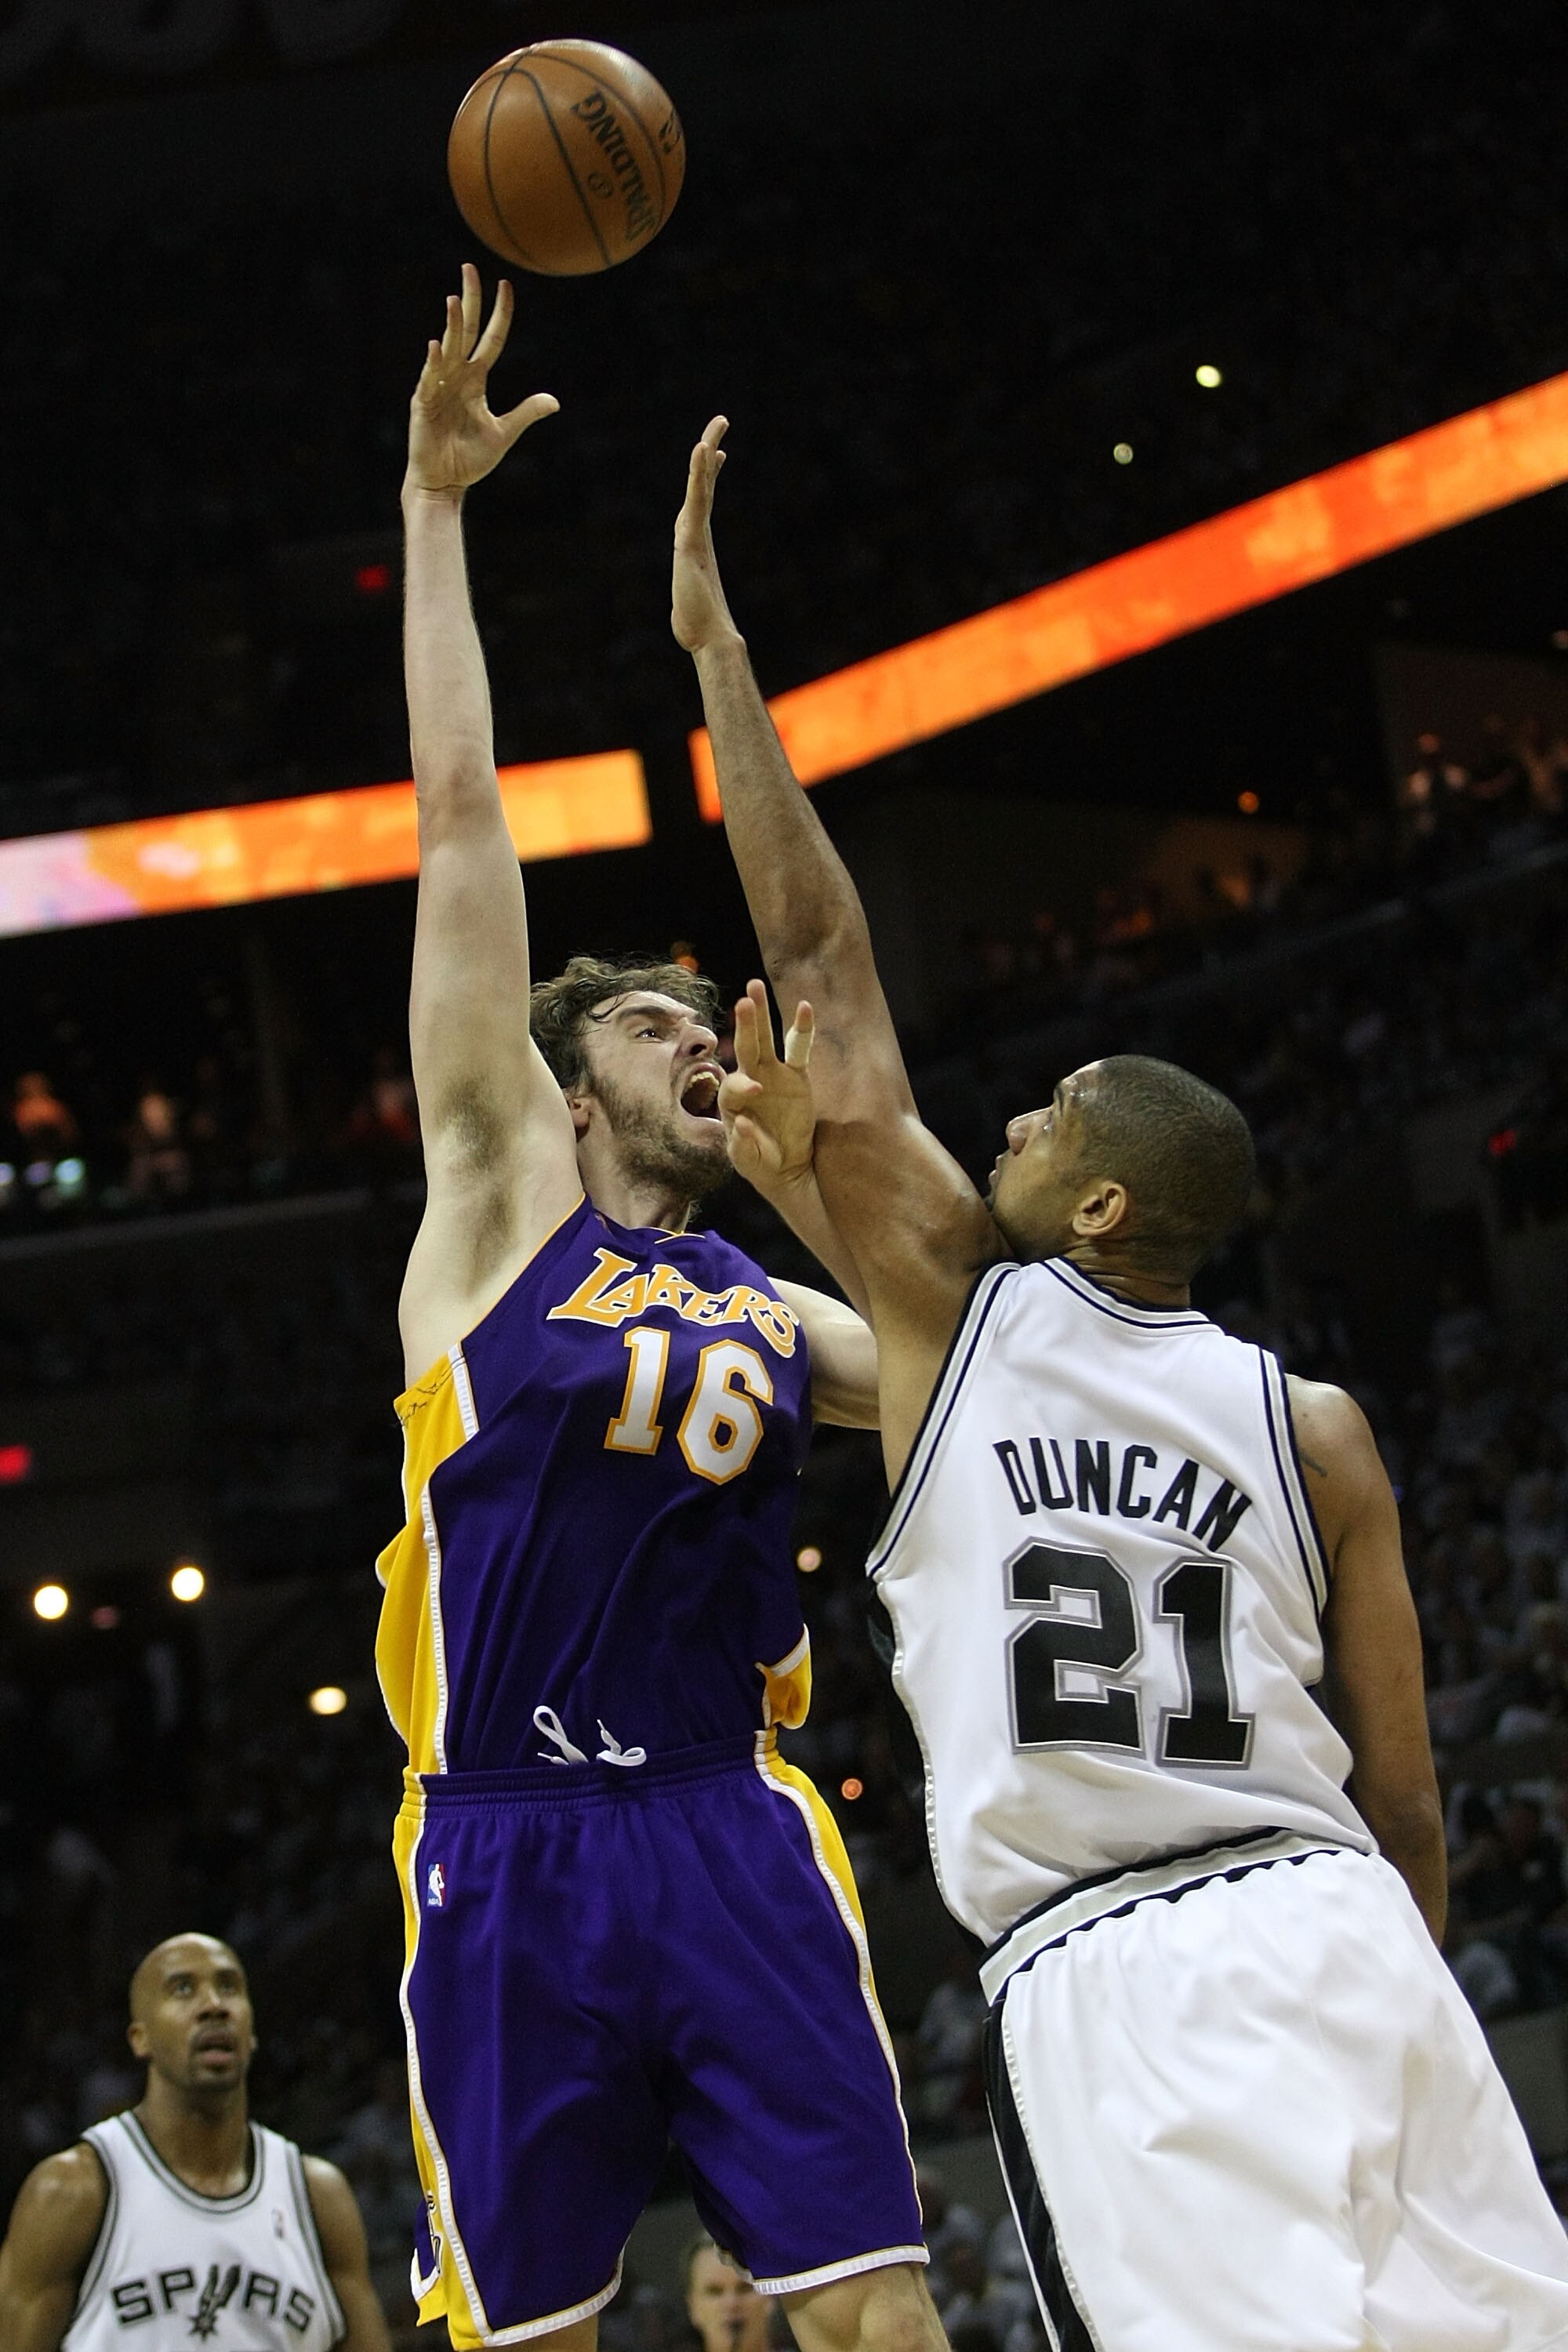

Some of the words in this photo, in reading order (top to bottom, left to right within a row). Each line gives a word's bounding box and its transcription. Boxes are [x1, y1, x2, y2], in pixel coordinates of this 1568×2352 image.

[546, 1247, 800, 1358] LAKERS
[604, 1326, 774, 1486] 16
[993, 1437, 1253, 1552] DUNCAN
[1002, 1536, 1256, 1769] 21
[111, 2264, 315, 2340] SPURS
